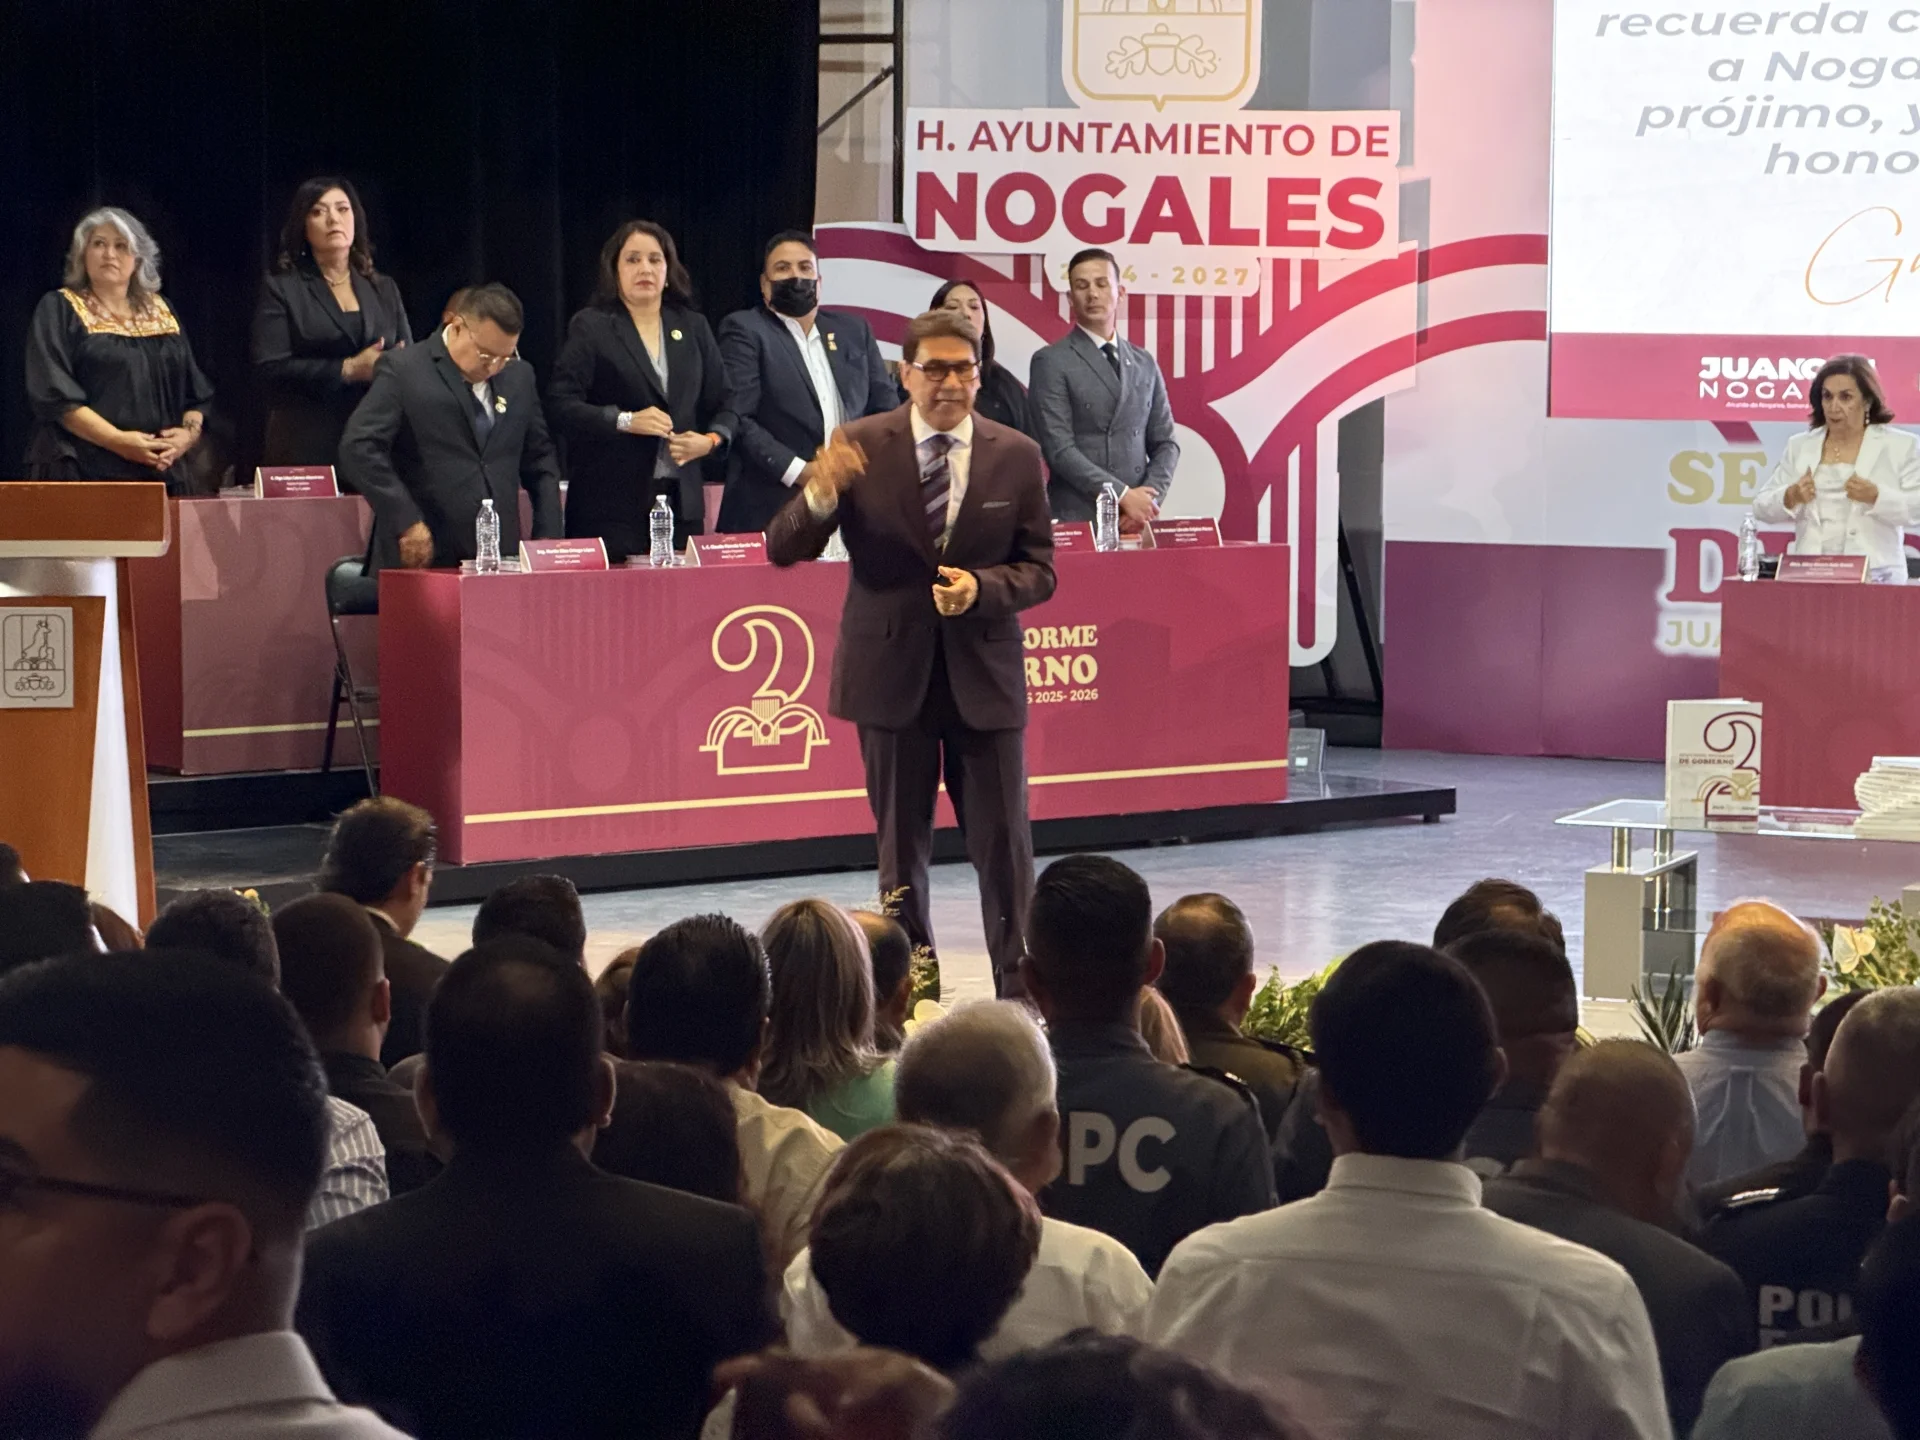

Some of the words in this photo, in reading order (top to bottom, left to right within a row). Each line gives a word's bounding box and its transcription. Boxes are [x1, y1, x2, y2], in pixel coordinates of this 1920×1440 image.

[1595, 2, 1868, 37] recuerda
[1708, 58, 1745, 83] a
[1763, 51, 1920, 89] Noga
[1635, 95, 1883, 136] prójimo,
[917, 121, 956, 152] H.
[968, 121, 1315, 157] AYUNTAMIENTO
[1331, 125, 1389, 158] DE
[1763, 143, 1920, 175] hono
[915, 171, 1386, 250] NOGALES
[1805, 206, 1920, 305] G
[1172, 266, 1249, 286] 2027
[1070, 688, 1099, 701] 2026
[1068, 1111, 1177, 1193] PC
